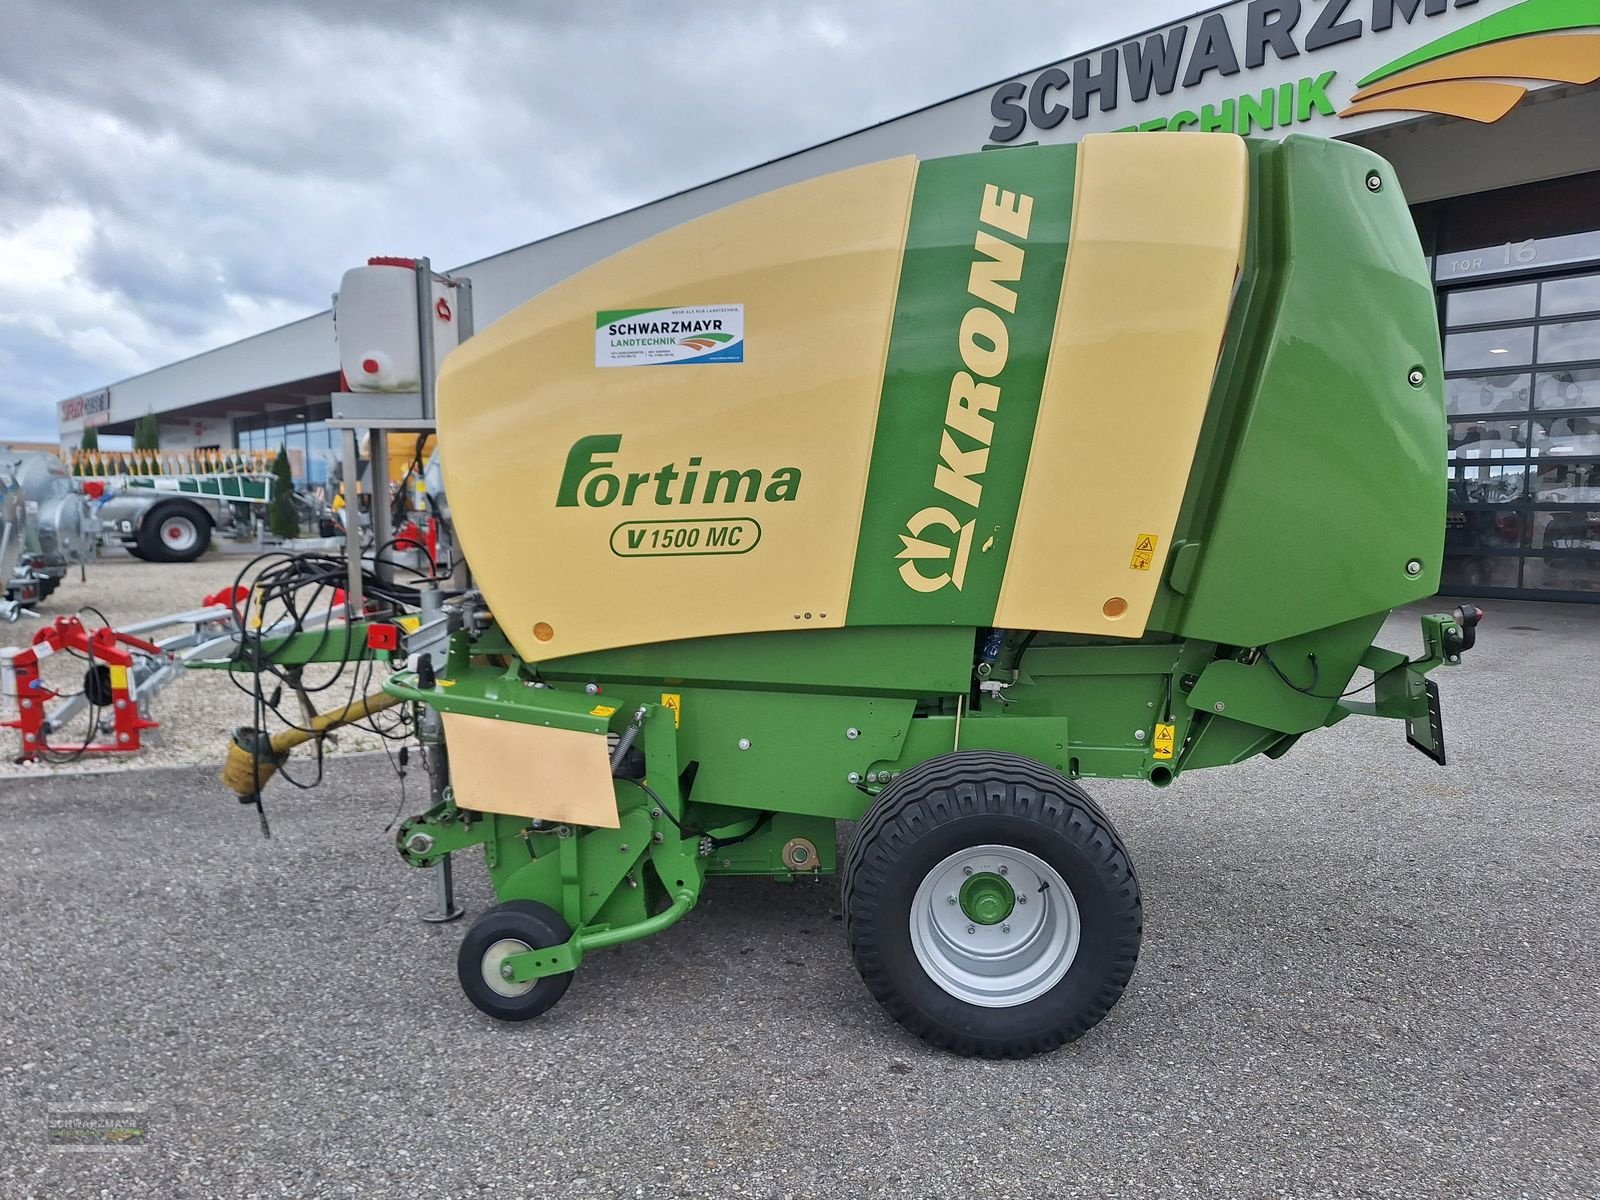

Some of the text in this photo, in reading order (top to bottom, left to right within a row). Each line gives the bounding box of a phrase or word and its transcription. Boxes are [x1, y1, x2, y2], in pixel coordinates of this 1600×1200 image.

[989, 0, 1480, 142] SCHWARZ
[1107, 70, 1338, 136] CHNIK
[1450, 238, 1537, 272] TOR 16
[608, 319, 723, 336] SCHWARZMAYR
[610, 337, 676, 347] LANDTECHNIK
[933, 183, 1034, 508] KRONE
[555, 433, 802, 507] Fortima
[627, 526, 743, 549] V 1500 MC
